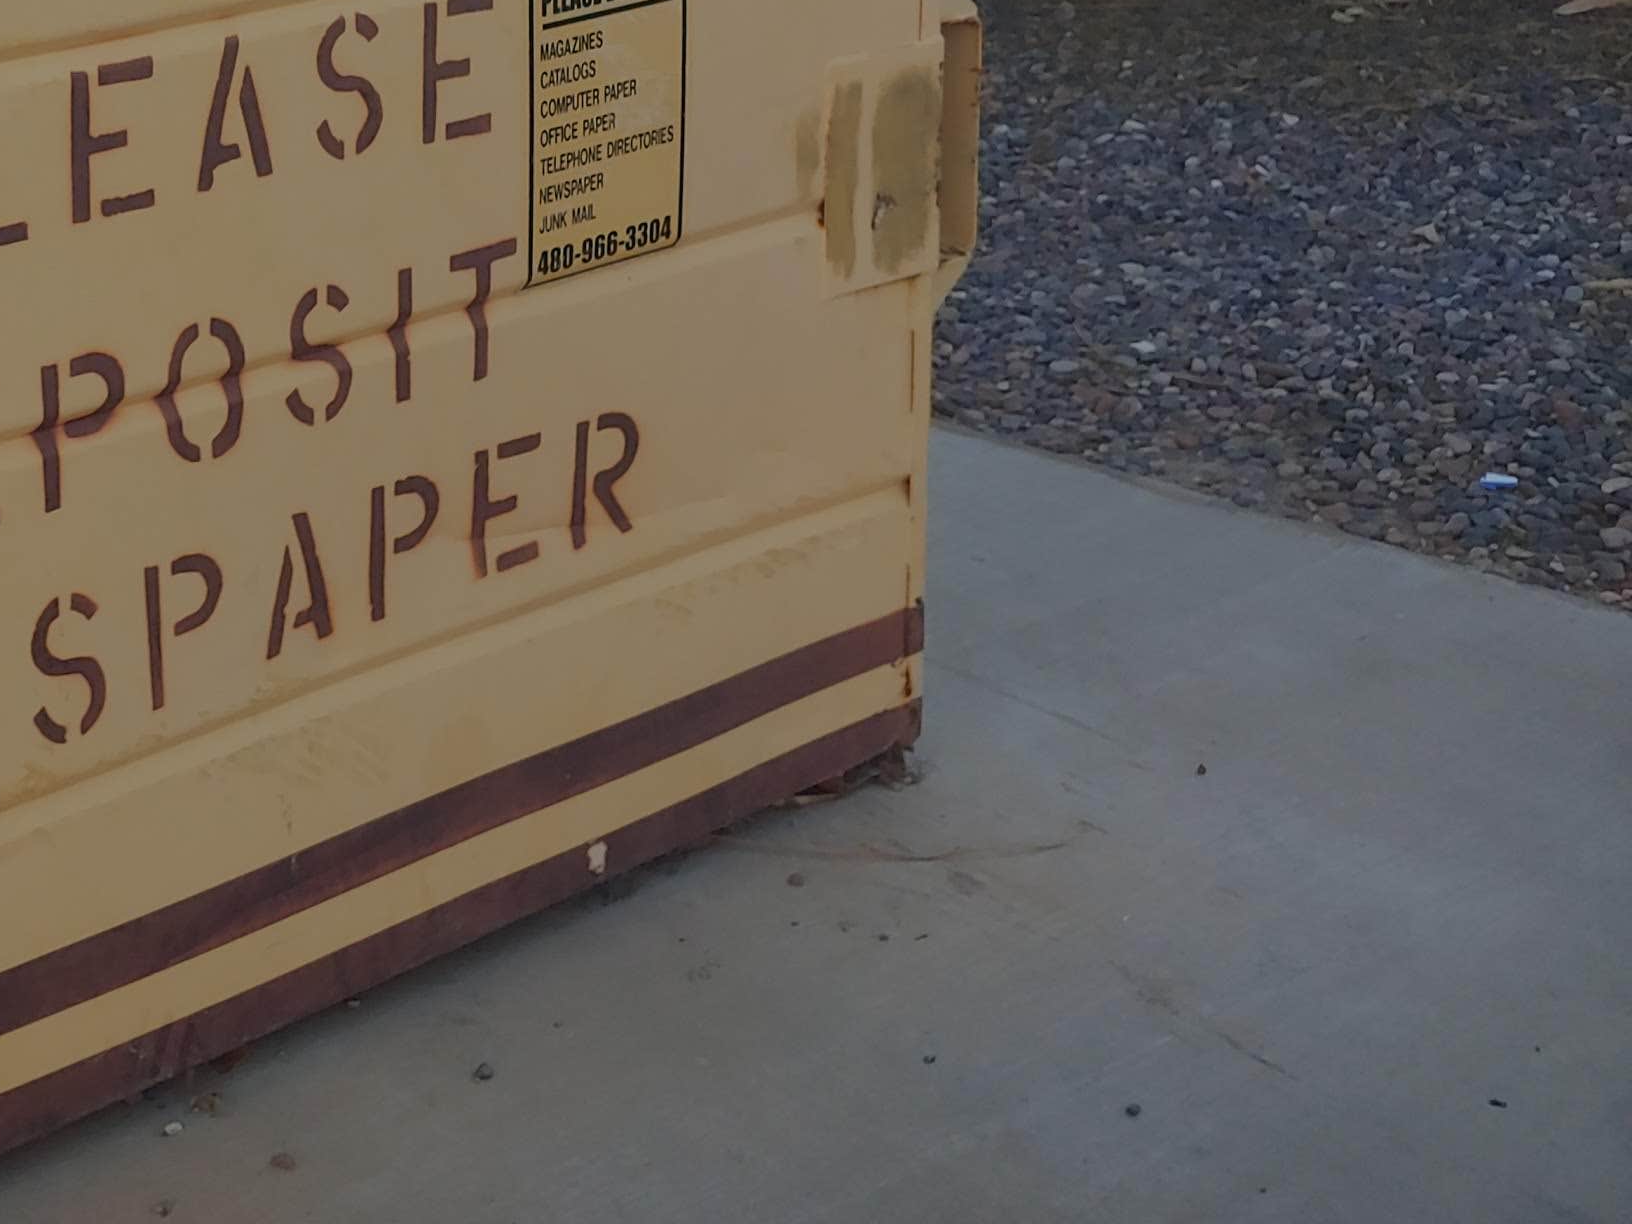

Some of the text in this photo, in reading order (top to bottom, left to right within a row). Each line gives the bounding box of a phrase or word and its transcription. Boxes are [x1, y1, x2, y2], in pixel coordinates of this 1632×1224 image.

[540, 30, 603, 62] MAGAZINES
[540, 60, 596, 89] CATALOGS
[540, 79, 637, 118] COMPUTER PAPER
[540, 112, 616, 147] OFFICE PAPER
[540, 125, 674, 176] TELEPHONE DIRECTORIES
[539, 172, 604, 204] NEWSPAPER
[539, 203, 596, 234] JUNK MAIL
[537, 215, 672, 275] 480-966-3304
